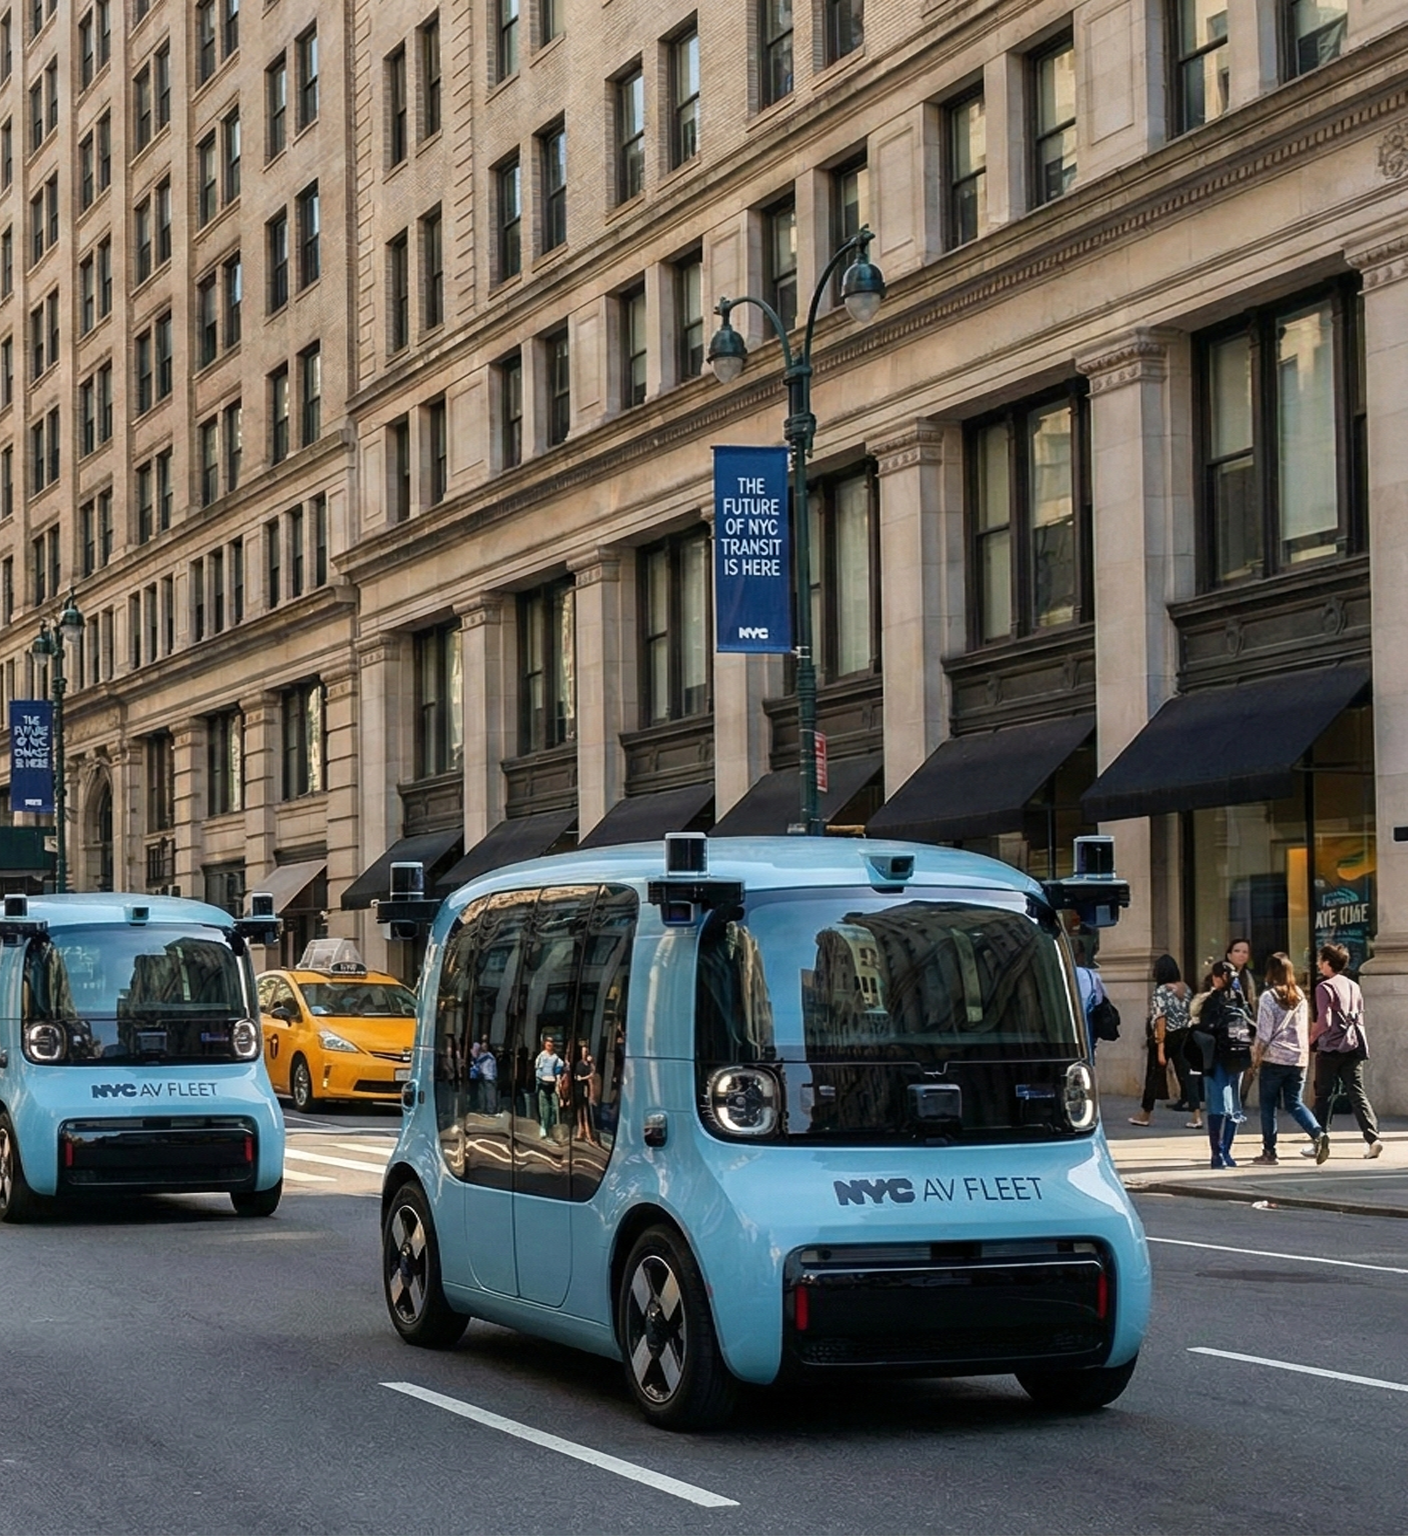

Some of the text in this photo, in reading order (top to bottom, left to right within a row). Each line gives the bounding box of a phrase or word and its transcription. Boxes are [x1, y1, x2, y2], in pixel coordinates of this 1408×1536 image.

[737, 477, 765, 494] THE
[723, 498, 780, 516] FUTURE
[725, 518, 778, 536] OF NYC
[721, 538, 782, 556] TRANSIT
[724, 558, 781, 577] IS HERE
[738, 627, 769, 639] NYC
[91, 1082, 217, 1098] NYC AV FLEET
[833, 1177, 1043, 1206] NYC AV FLEET
